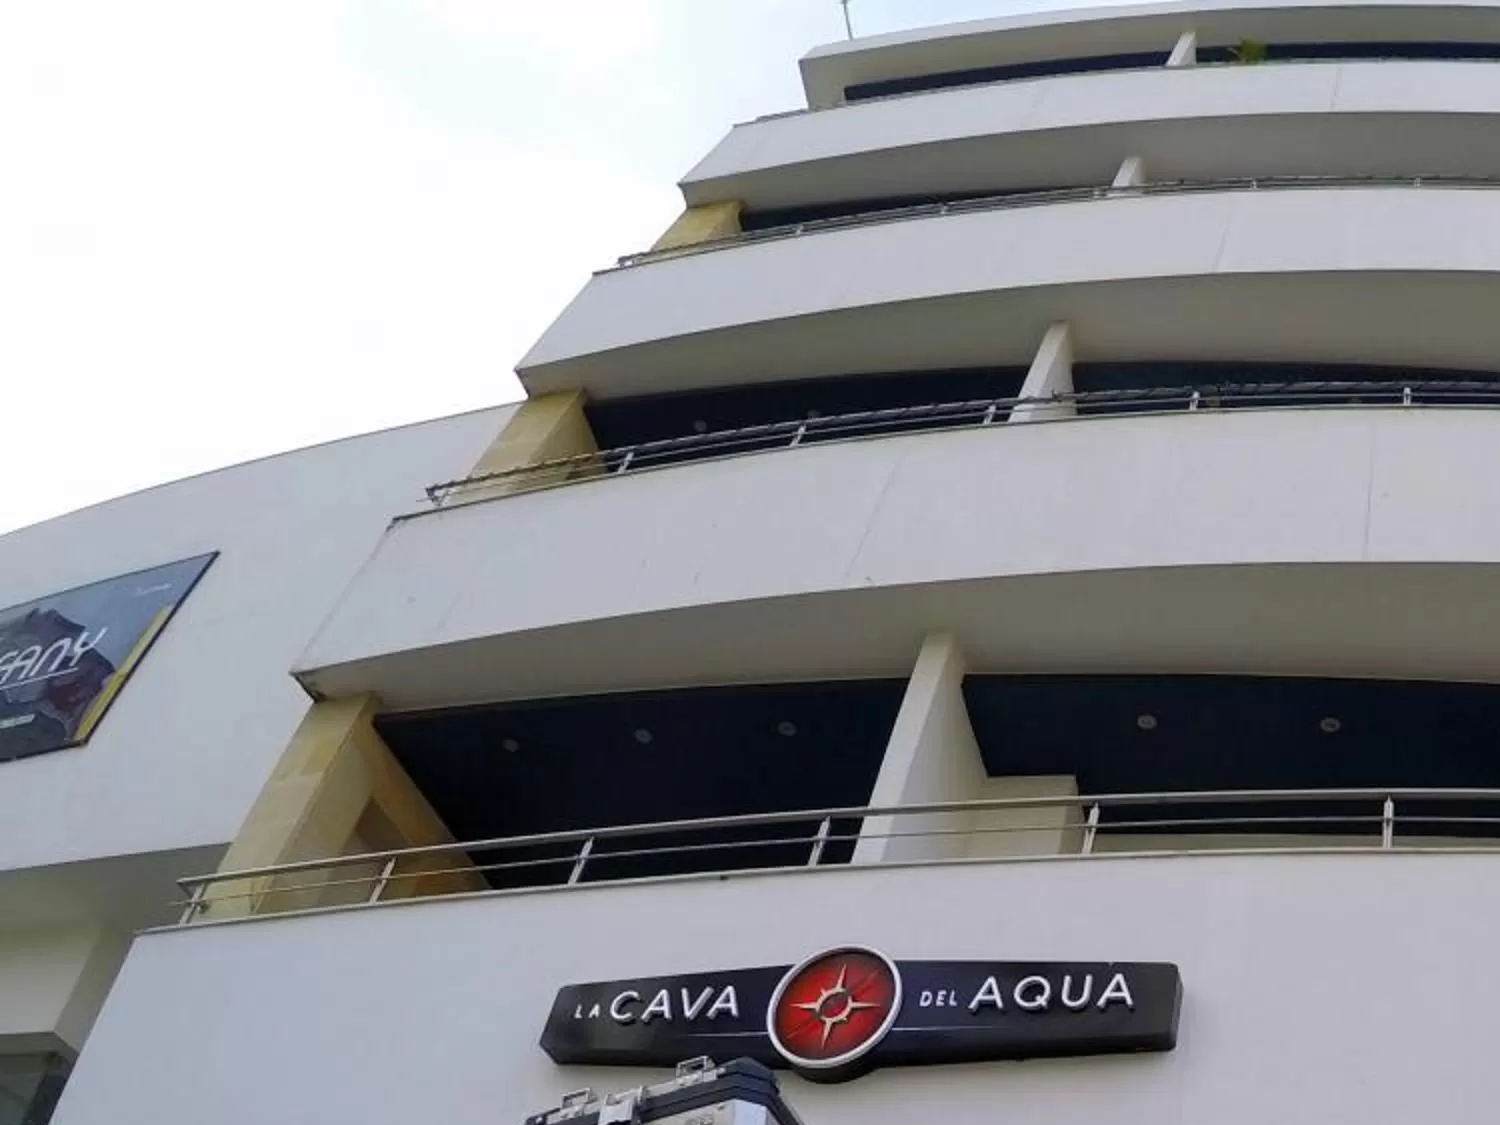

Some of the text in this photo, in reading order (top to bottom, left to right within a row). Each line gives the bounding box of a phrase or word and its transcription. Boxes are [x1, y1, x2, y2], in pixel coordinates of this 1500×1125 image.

[573, 985, 740, 1023] LA CAVA
[918, 973, 1135, 1011] DEL AQUA
